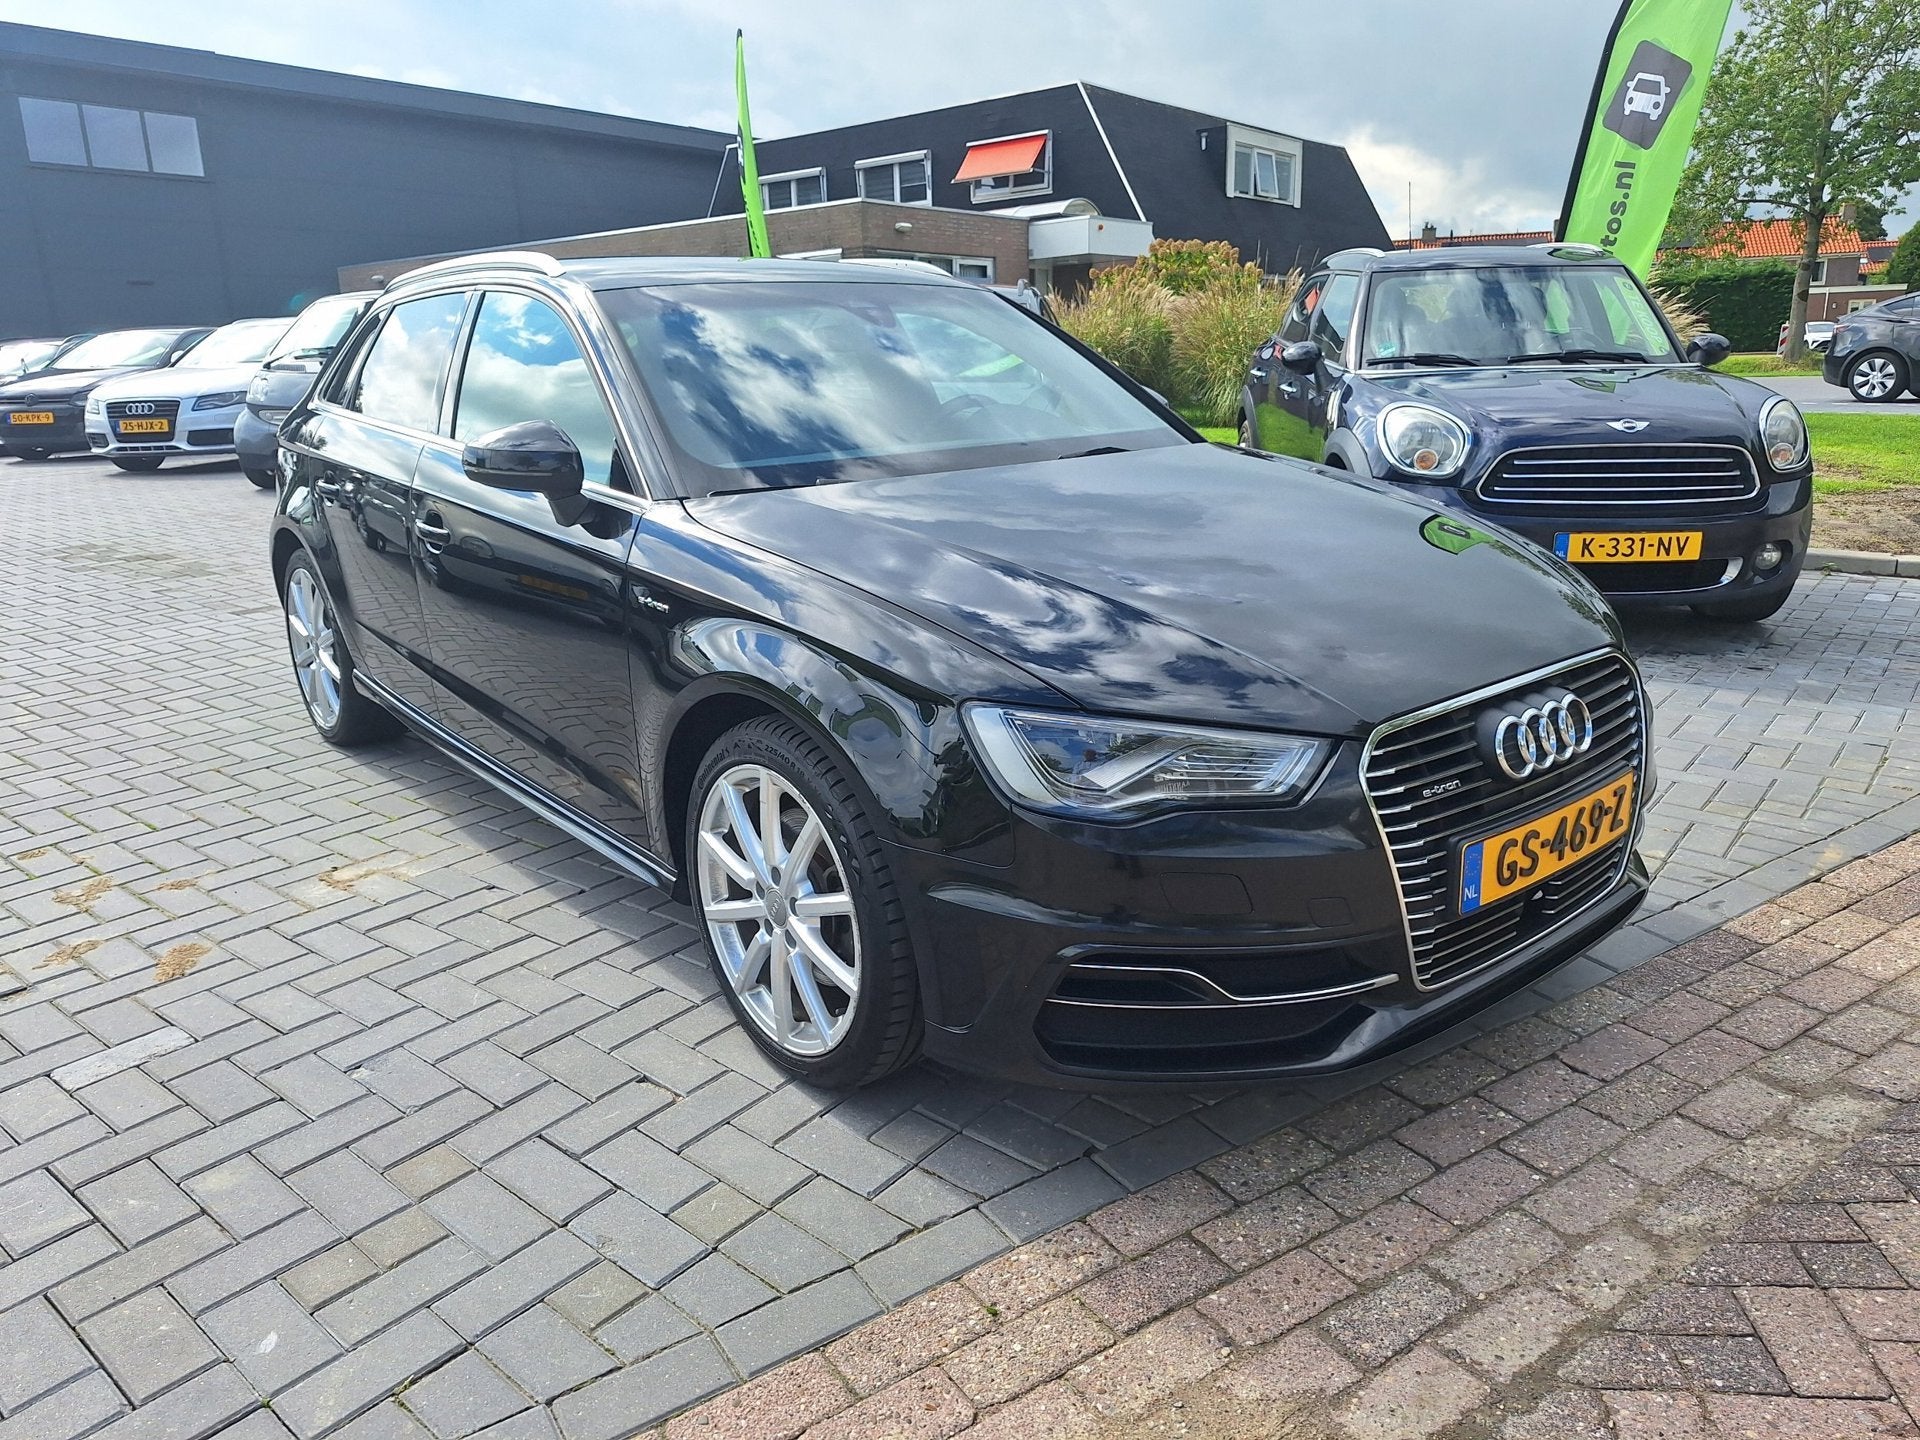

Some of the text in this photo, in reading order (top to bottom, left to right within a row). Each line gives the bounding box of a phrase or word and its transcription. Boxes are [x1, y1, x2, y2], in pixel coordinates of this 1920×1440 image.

[1600, 161, 1637, 256] tos.nl
[12, 413, 50, 424] 50-KPK-9
[122, 421, 164, 431] 25-HJX-2
[1580, 536, 1690, 558] K-331-NV
[1422, 779, 1461, 798] e-tron
[1496, 784, 1628, 887] GS-469-Z
[1463, 884, 1478, 900] NL
